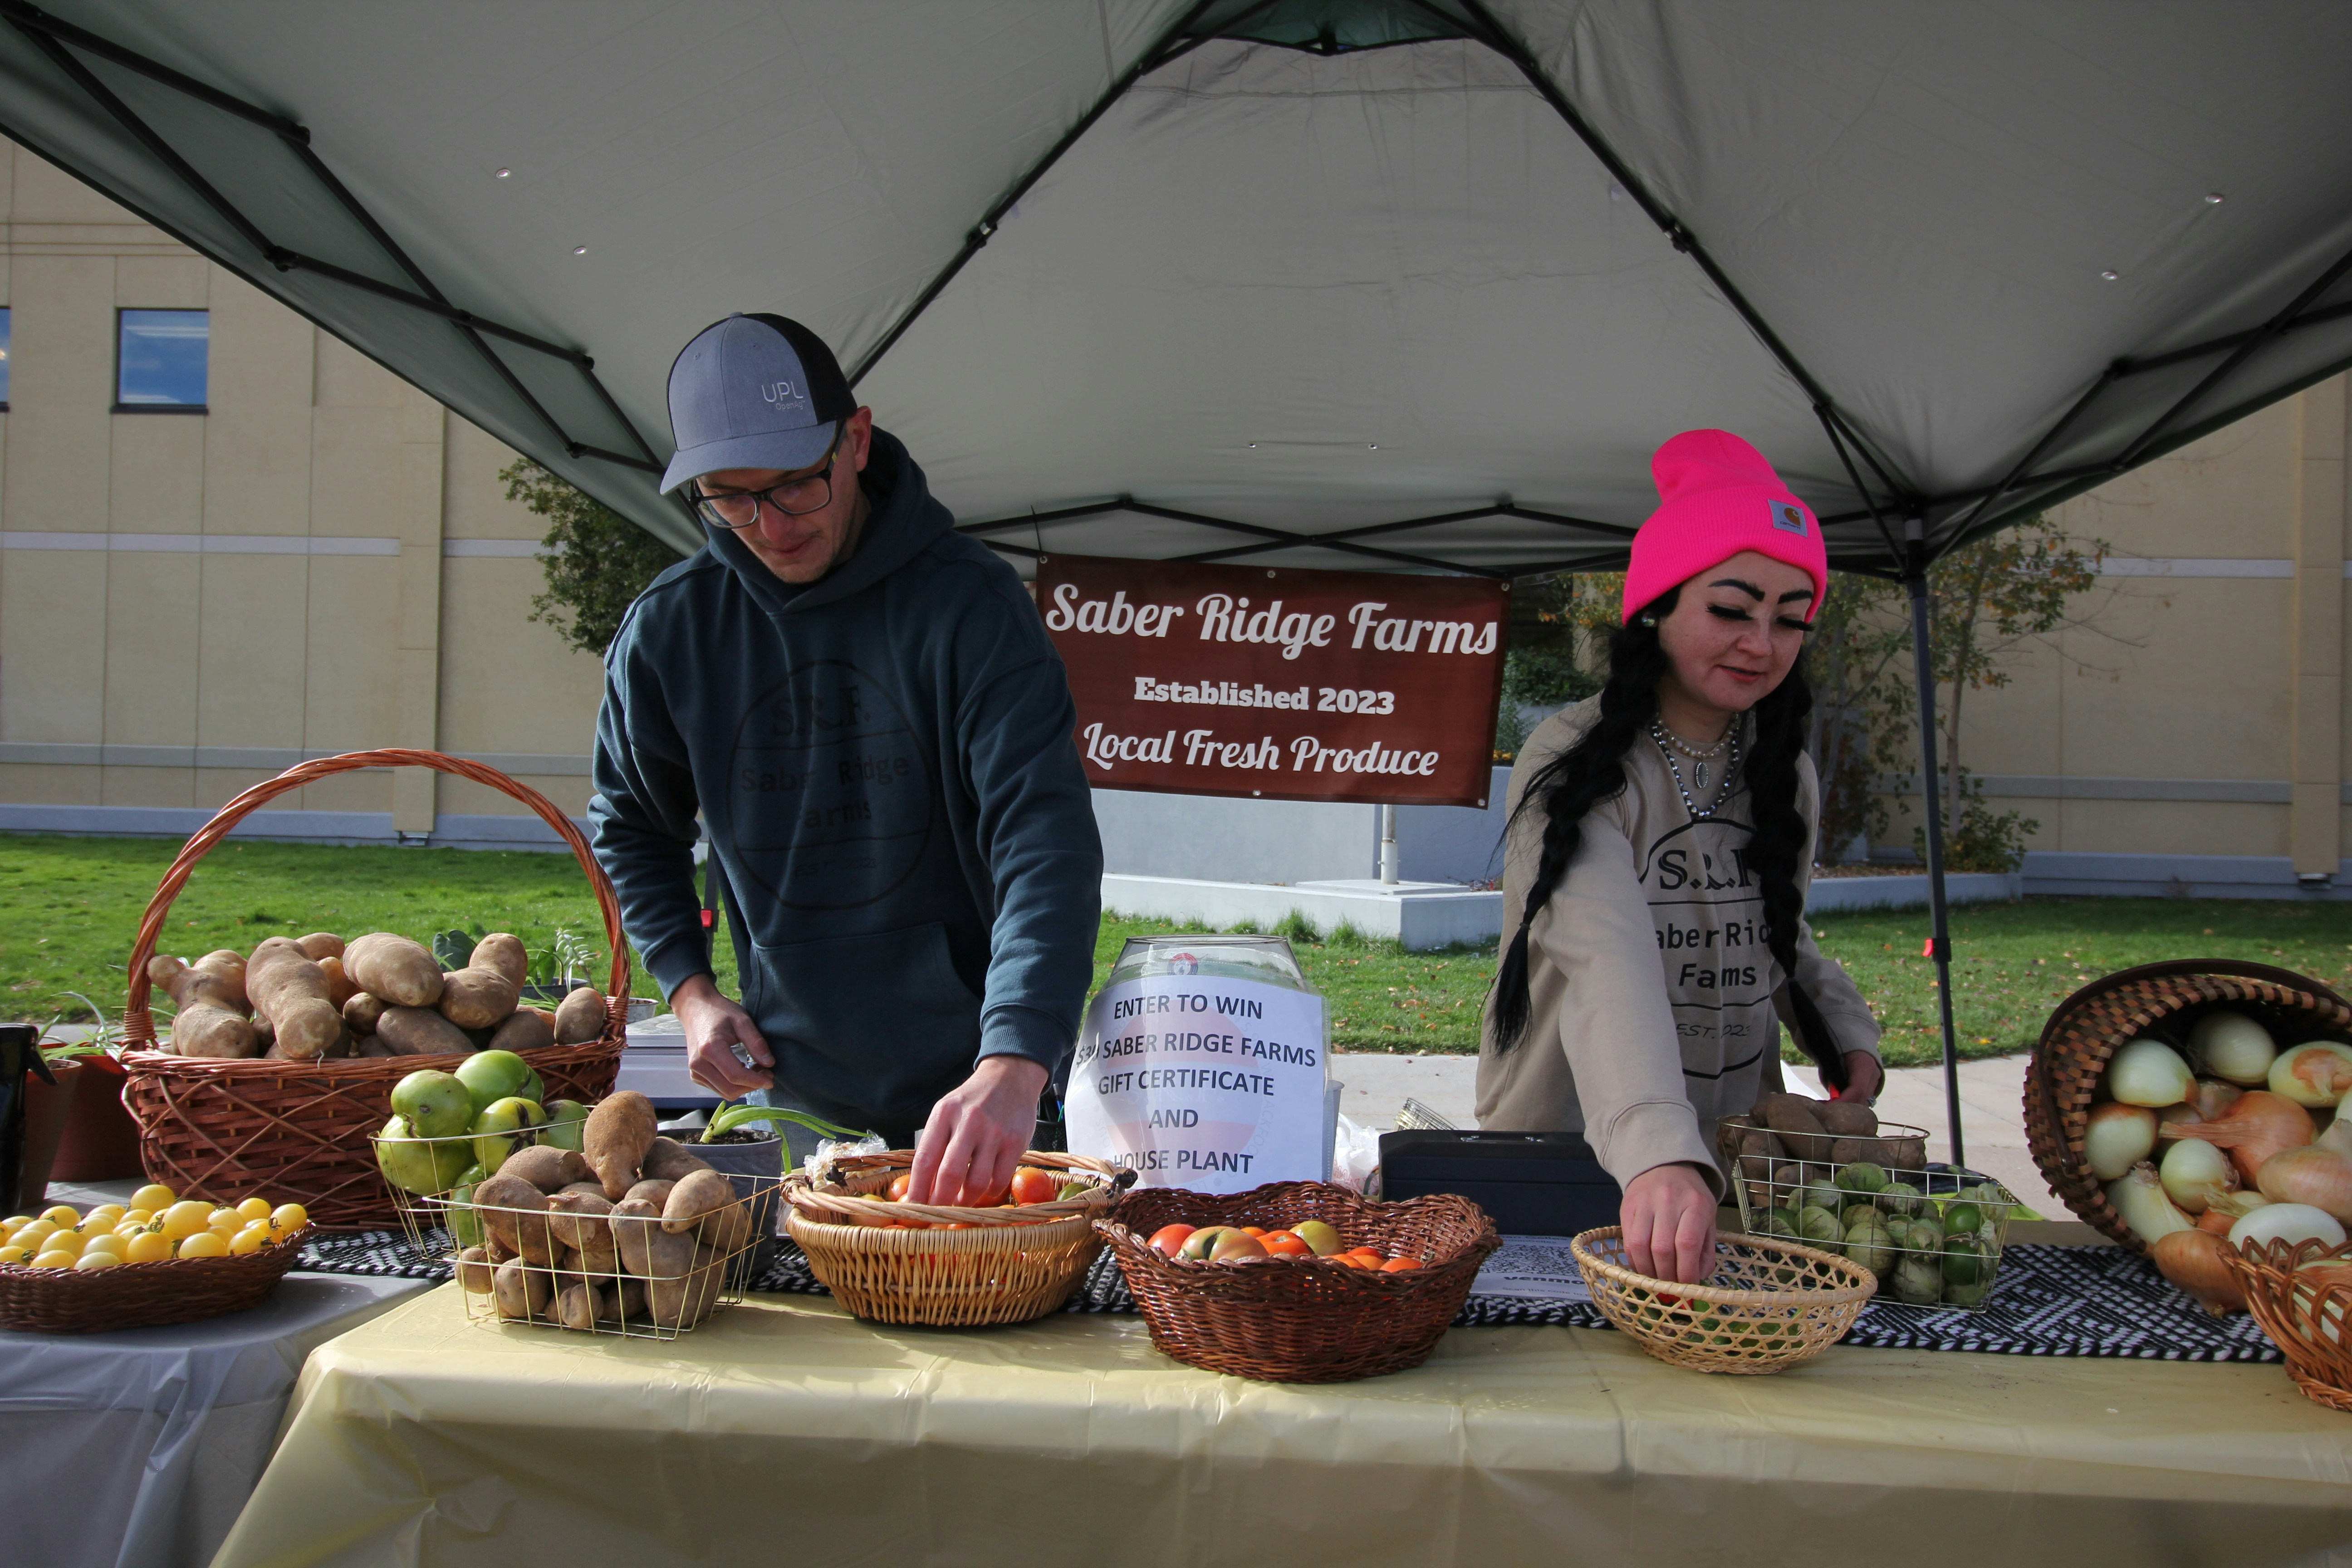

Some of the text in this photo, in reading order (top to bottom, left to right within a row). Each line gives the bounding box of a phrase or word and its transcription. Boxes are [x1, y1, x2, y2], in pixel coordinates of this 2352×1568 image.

[761, 381, 804, 403] UPL
[1046, 584, 1498, 660] Saber Ridge Farms
[1134, 676, 1395, 715] Established 2023
[1083, 723, 1439, 776] Local Fresh Produce
[838, 754, 909, 786] Ridge
[804, 800, 872, 830] arms
[1656, 922, 1720, 950] aber
[1678, 963, 1757, 990] Fams
[1114, 995, 1170, 1020] ENTER
[1176, 994, 1208, 1013] TO
[1215, 995, 1262, 1020] WIN
[1676, 1024, 1715, 1039] EST.
[1102, 1034, 1157, 1059] SABER
[1164, 1033, 1234, 1054] RIDGE
[1241, 1037, 1316, 1067] FARMS
[1099, 1073, 1133, 1095] GIFT
[1138, 1069, 1274, 1096] CERTIFICATE
[1148, 1109, 1199, 1129] AND
[1114, 1150, 1169, 1171] HOUSE
[1177, 1150, 1254, 1174] PLANT
[1503, 1276, 1585, 1285] venmo
